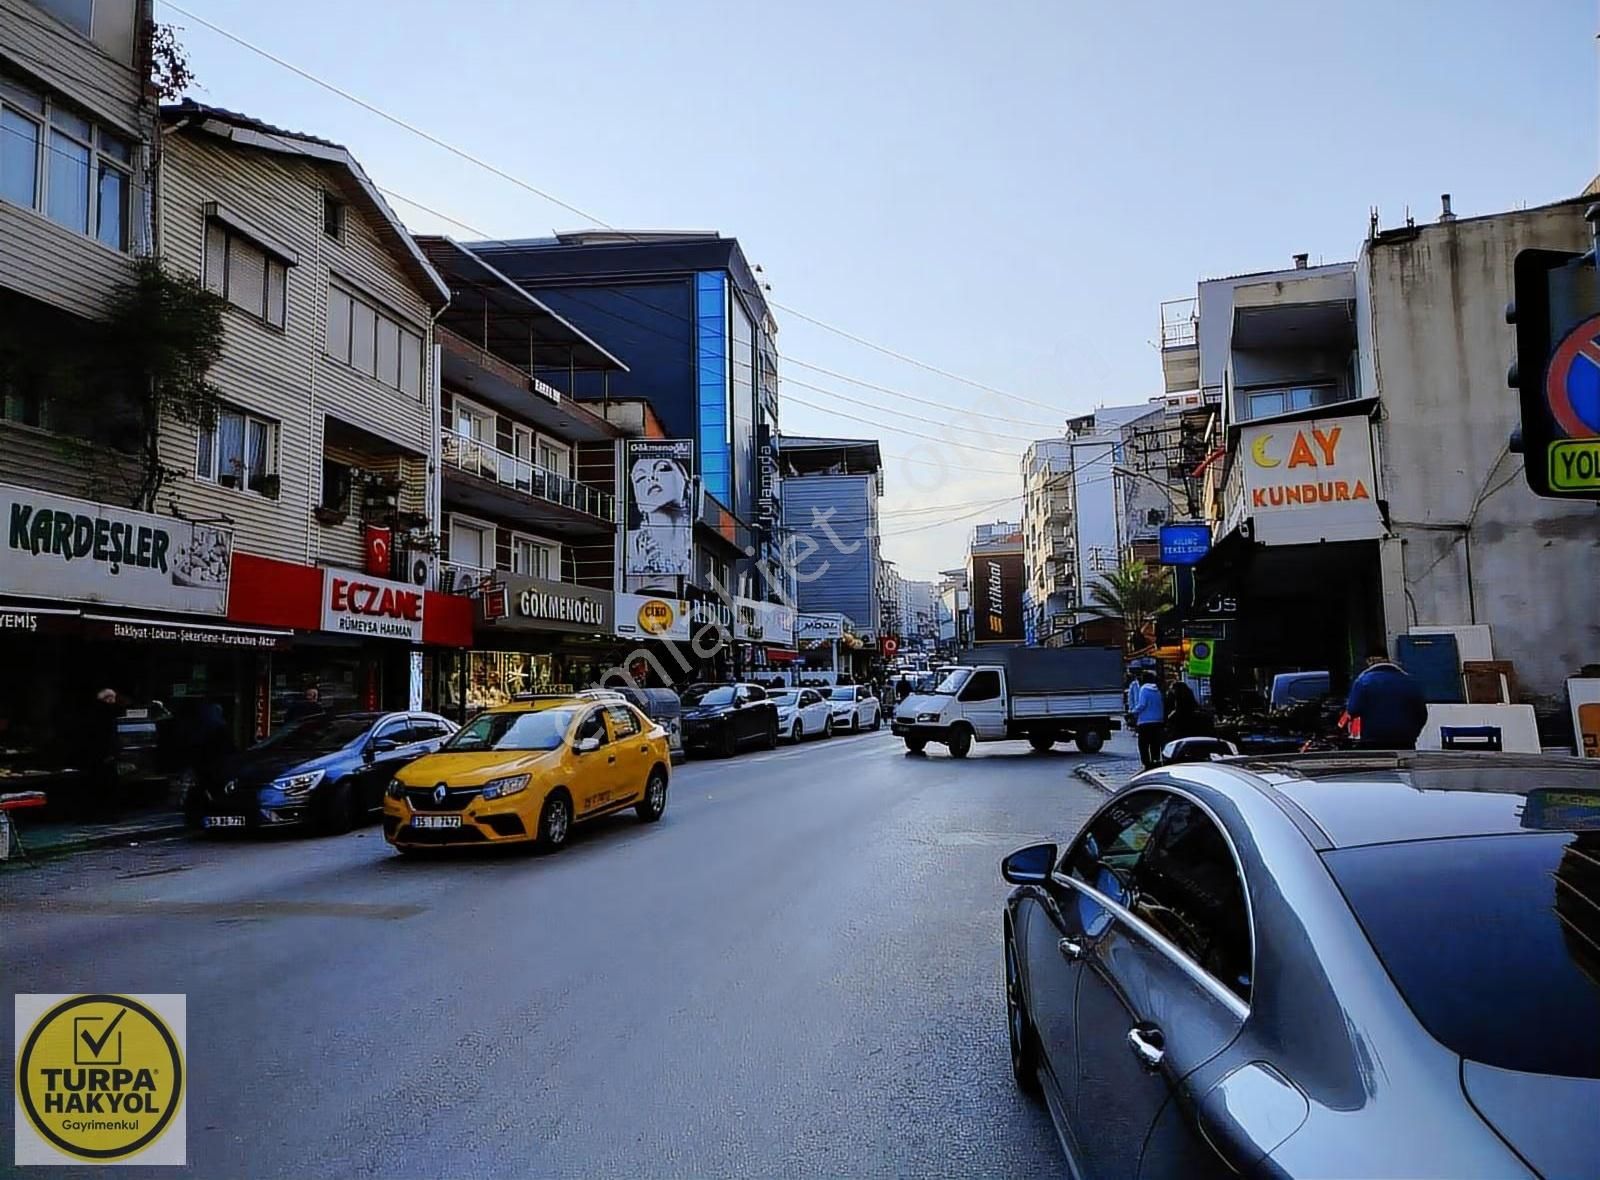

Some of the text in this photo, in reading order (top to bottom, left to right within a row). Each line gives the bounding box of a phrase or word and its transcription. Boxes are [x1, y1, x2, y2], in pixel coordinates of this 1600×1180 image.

[1288, 427, 1342, 468] AY
[1252, 479, 1369, 507] KUNDURA
[9, 503, 169, 575] KARDEŞLER
[331, 578, 422, 622] ECZANE
[339, 616, 412, 638] RÜMEYSA HARMAN
